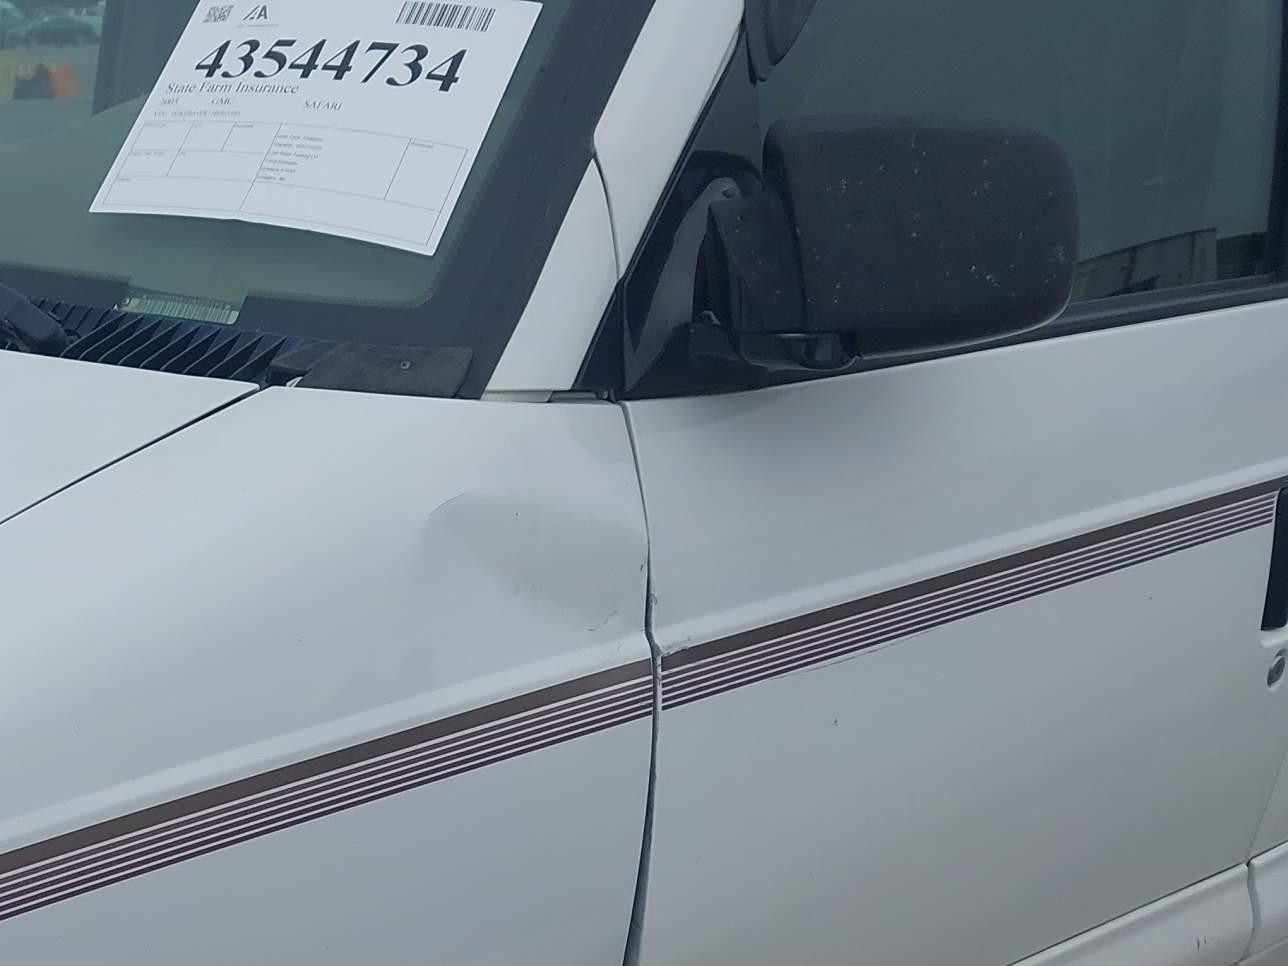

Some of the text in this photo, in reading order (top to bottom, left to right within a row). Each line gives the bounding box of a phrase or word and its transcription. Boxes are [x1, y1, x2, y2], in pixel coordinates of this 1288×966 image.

[194, 38, 467, 92] 43544734
[166, 81, 300, 95] State Farm Insurance
[304, 100, 343, 111] SAFARI
